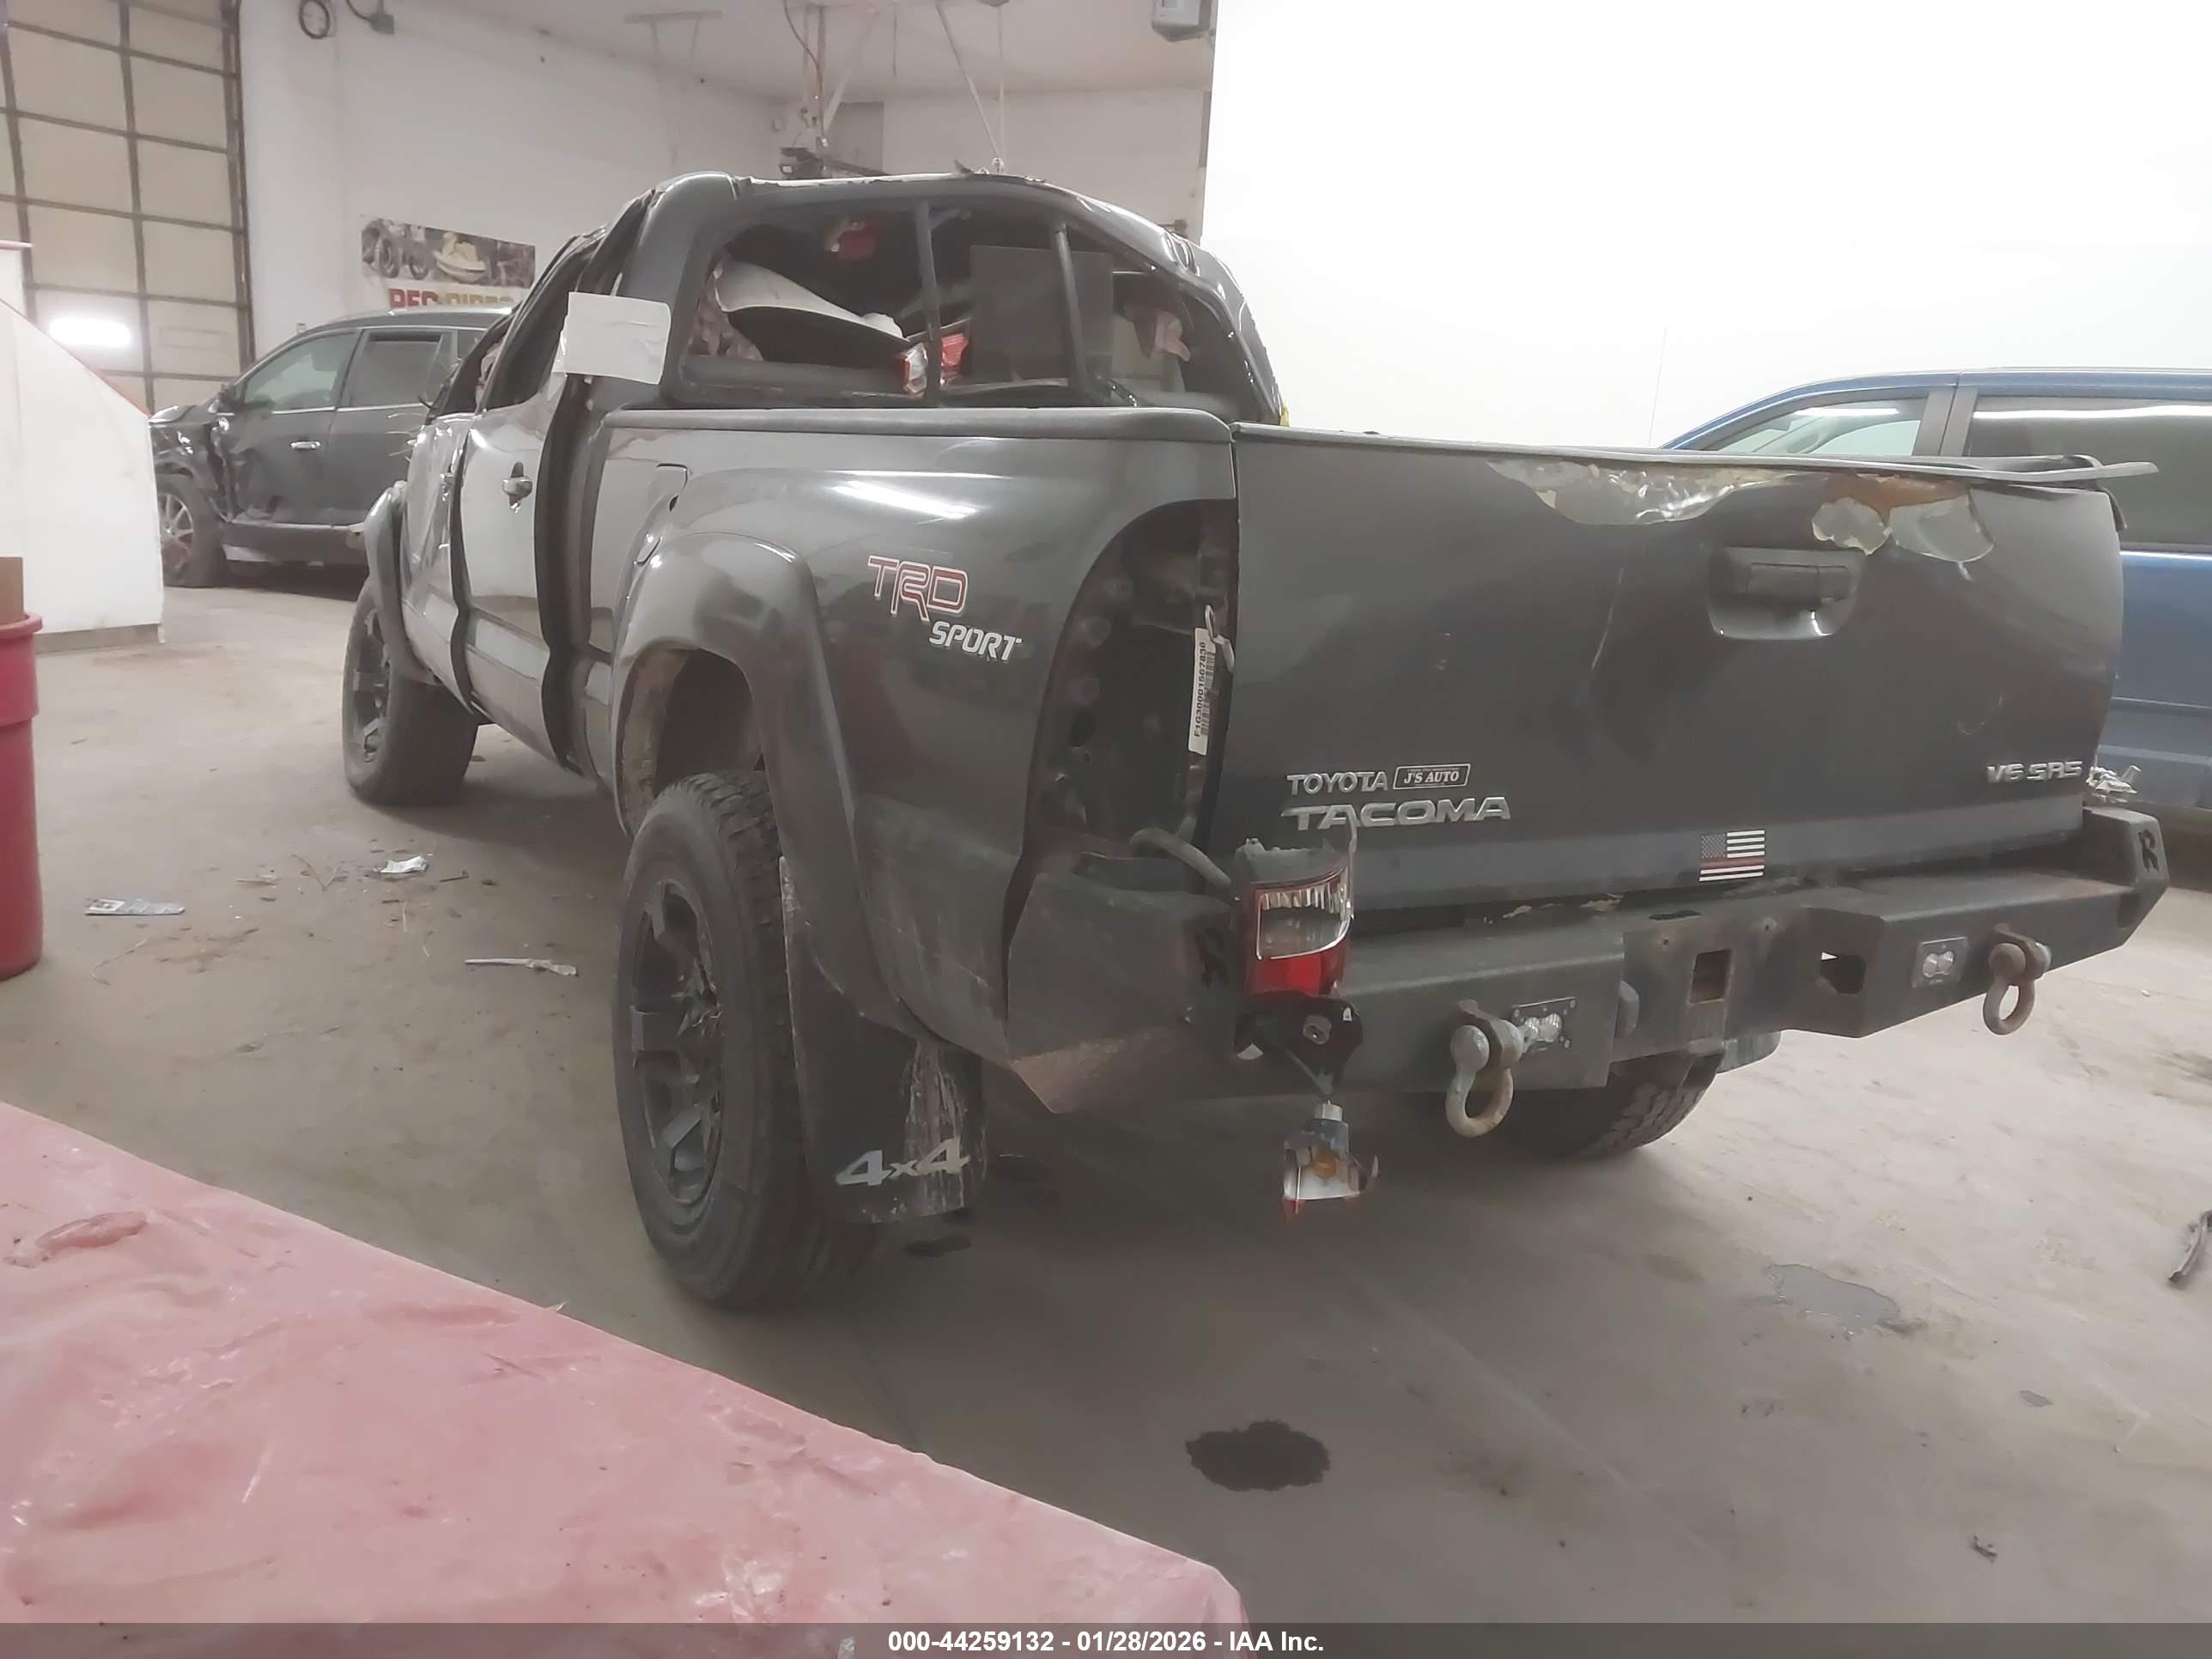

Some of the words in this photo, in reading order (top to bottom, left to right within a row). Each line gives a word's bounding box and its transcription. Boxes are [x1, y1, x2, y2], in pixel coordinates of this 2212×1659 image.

[867, 555, 969, 622] TRD
[929, 621, 1022, 661] SPORT
[1286, 771, 1389, 795] TOYOTA
[1403, 772, 1423, 784] J'S
[1425, 771, 1460, 783] AUTO
[1986, 763, 2024, 783] V6
[1280, 797, 1510, 830] TACOMA
[836, 1138, 970, 1186] 4x4
